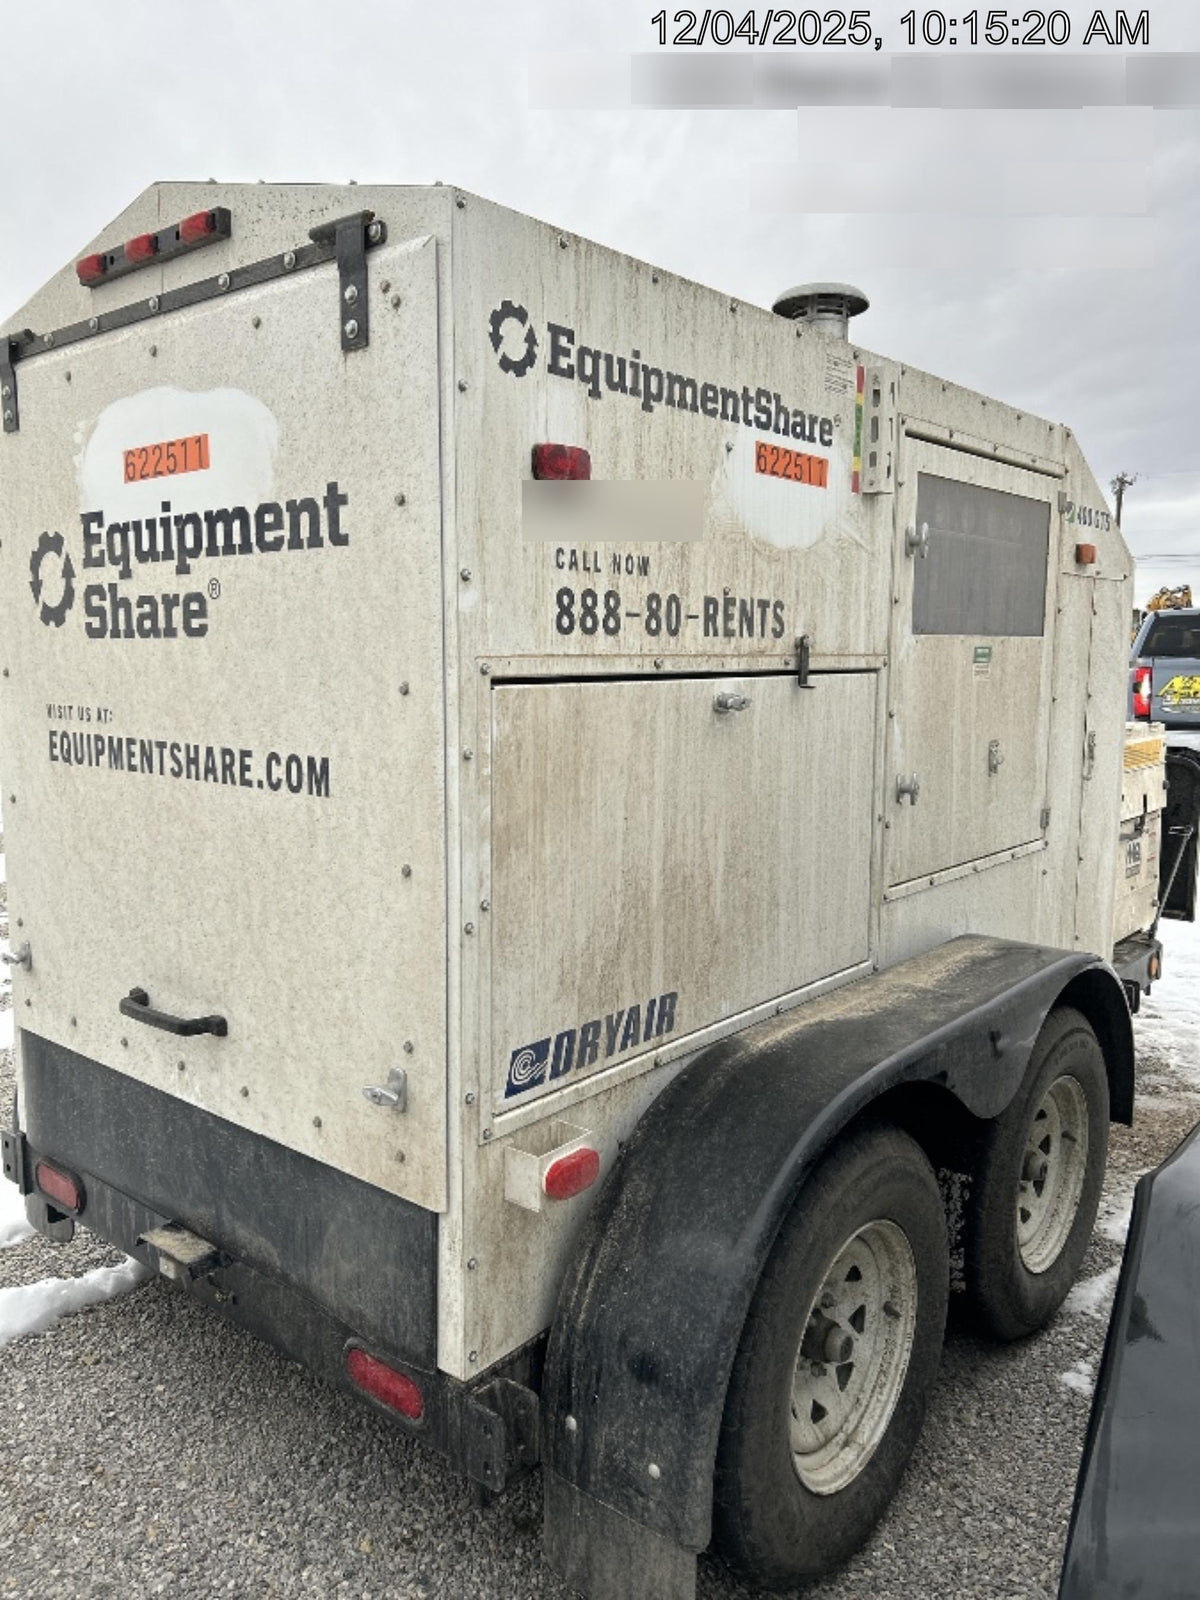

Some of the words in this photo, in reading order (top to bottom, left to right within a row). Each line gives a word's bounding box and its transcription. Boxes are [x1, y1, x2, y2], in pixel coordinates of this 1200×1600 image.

[546, 321, 834, 447] EquipmentShare
[125, 433, 207, 481] 622511
[756, 442, 828, 488] 622511
[80, 481, 349, 580] Equipment
[555, 547, 601, 575] CALL
[612, 552, 651, 577] NOW
[555, 586, 786, 640] 888-80-RENTS
[46, 703, 73, 720] VISIT
[77, 705, 91, 722] US
[48, 729, 331, 798] EQUIPMENTSHARE.COM
[549, 991, 679, 1082] DRYAIR
